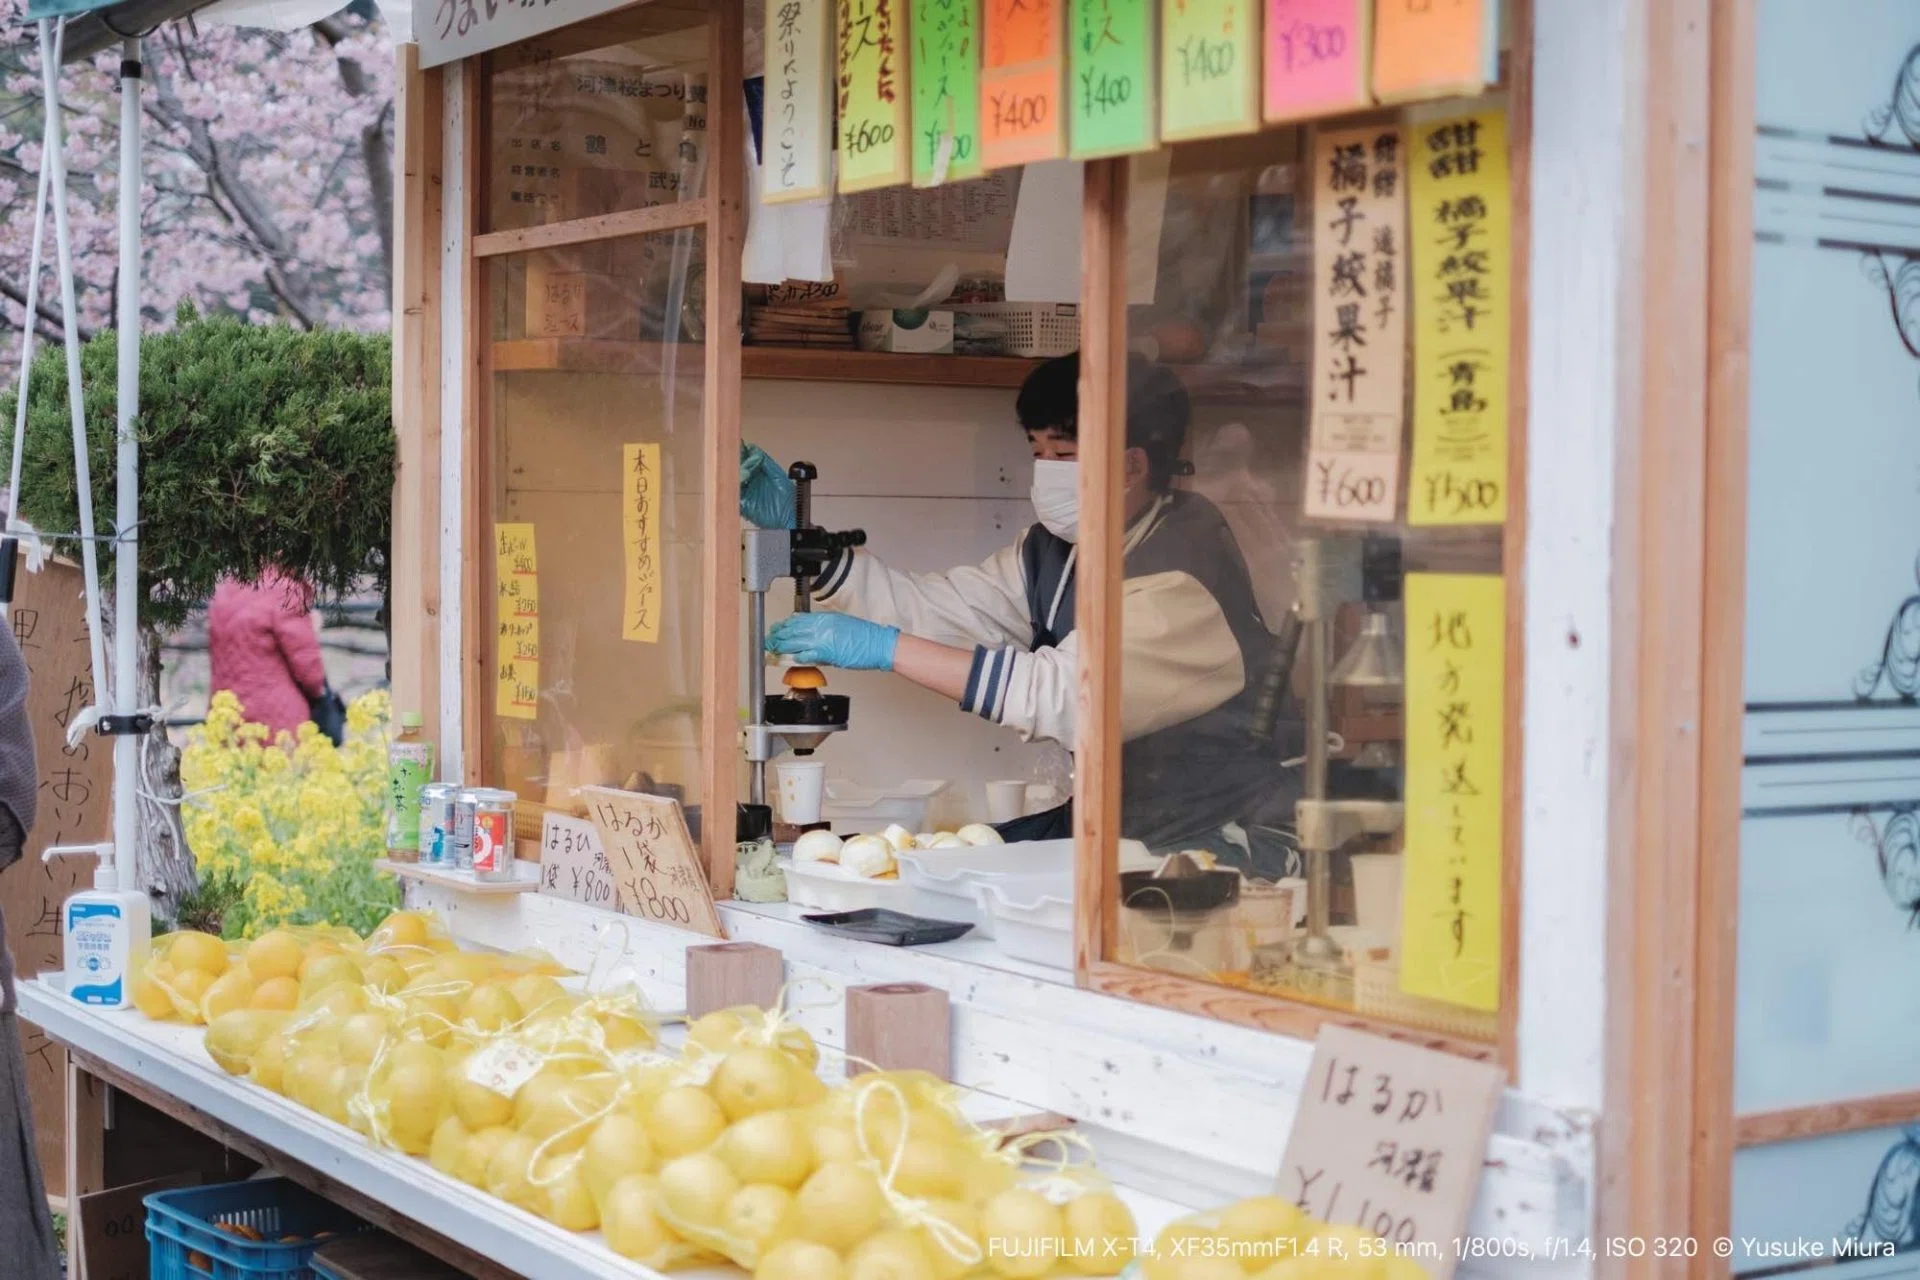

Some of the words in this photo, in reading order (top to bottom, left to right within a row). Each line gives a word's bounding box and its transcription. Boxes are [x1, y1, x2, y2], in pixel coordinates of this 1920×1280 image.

[1177, 34, 1234, 87] ¥400
[1280, 20, 1347, 72] ¥300
[990, 91, 1047, 136] ¥400
[1080, 65, 1132, 118] ¥400
[1317, 457, 1386, 507] ¥600
[597, 803, 668, 840] はるか
[572, 867, 611, 903] ¥800
[625, 876, 691, 924] ¥800
[1322, 1058, 1444, 1124] はるか
